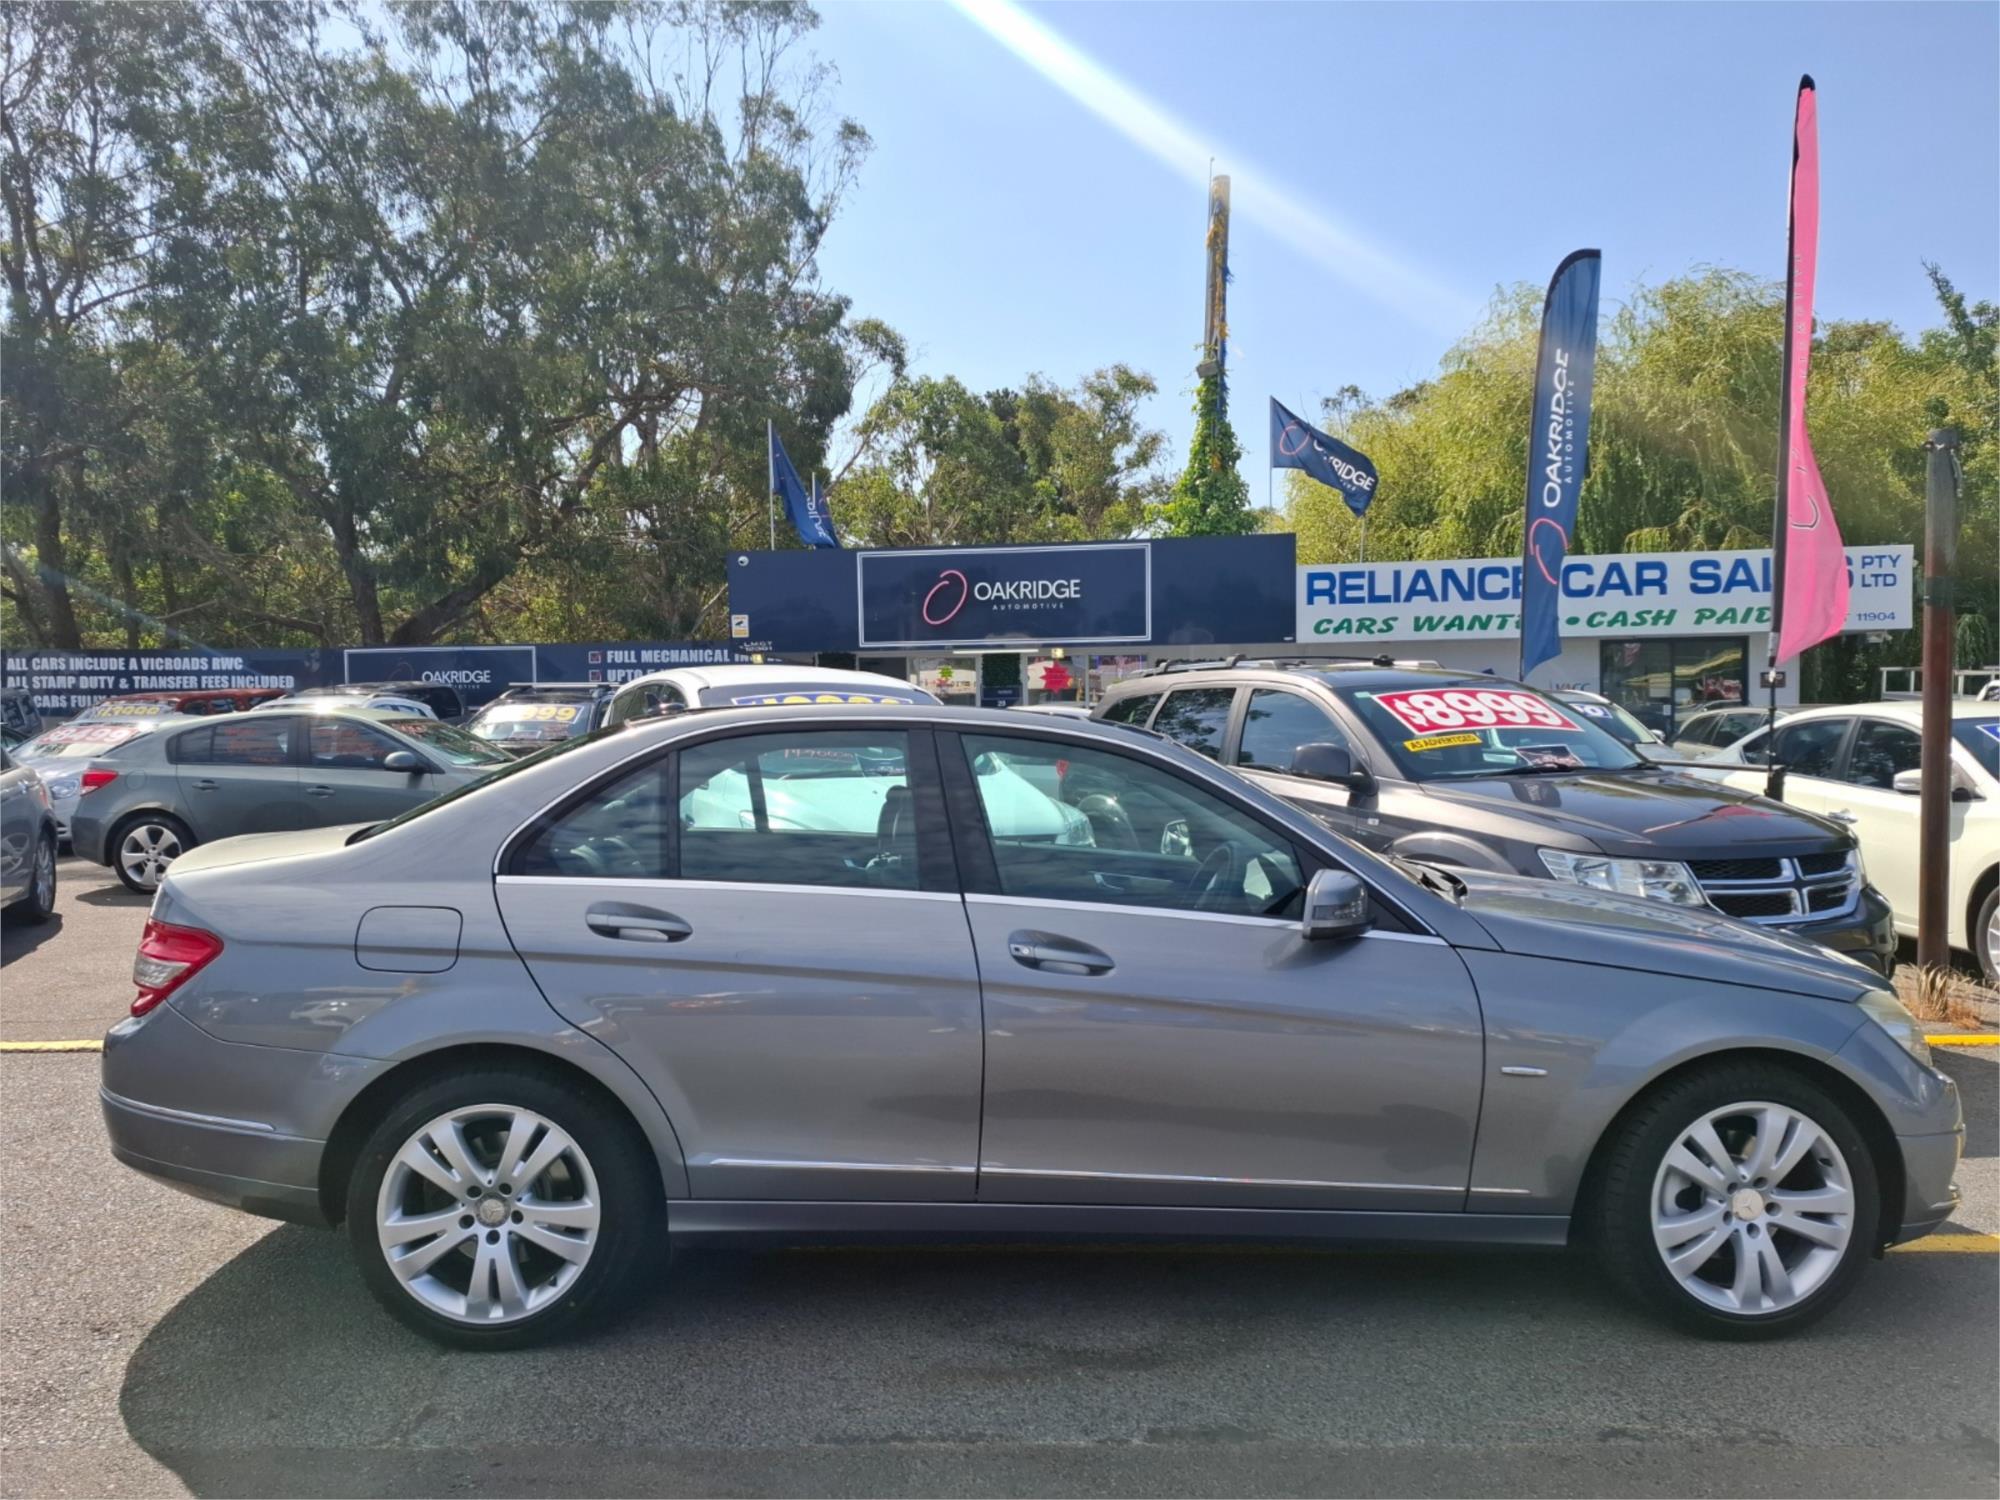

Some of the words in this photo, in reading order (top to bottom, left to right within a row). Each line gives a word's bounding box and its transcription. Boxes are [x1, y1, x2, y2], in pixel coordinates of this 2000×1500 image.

[1543, 348, 1568, 508] OAKRIDGE
[1564, 380, 1575, 484] AUTOMOTIVE
[1861, 554, 1901, 569] PTY
[1561, 562, 1668, 597] CAR
[1861, 573, 1897, 588] LTD
[974, 579, 1081, 601] OAKRIDGE
[992, 602, 1064, 611] AUTOMOTIVE
[1313, 616, 1399, 635] CARS
[1412, 613, 1522, 632] WANT
[1586, 608, 1677, 629] CASH
[1857, 612, 1896, 621] 11904
[6, 657, 28, 671] ALL
[31, 657, 66, 671] CARS
[69, 657, 126, 671] INCLUDE
[128, 657, 138, 671] A
[140, 657, 208, 671] VICROADS
[211, 657, 243, 671] RWC
[606, 651, 637, 664] FULL
[641, 649, 730, 663] MECHANICAL
[6, 675, 29, 689] ALL
[31, 675, 76, 689] STAMP
[79, 675, 115, 689] DUTY
[118, 677, 129, 689] &
[132, 675, 198, 689] TRANSFER
[200, 675, 230, 689] FEES
[231, 675, 295, 689] INCLUDED
[422, 670, 491, 684] OAKRIDGE
[33, 695, 67, 708] CARS
[1393, 692, 1563, 727] $8999
